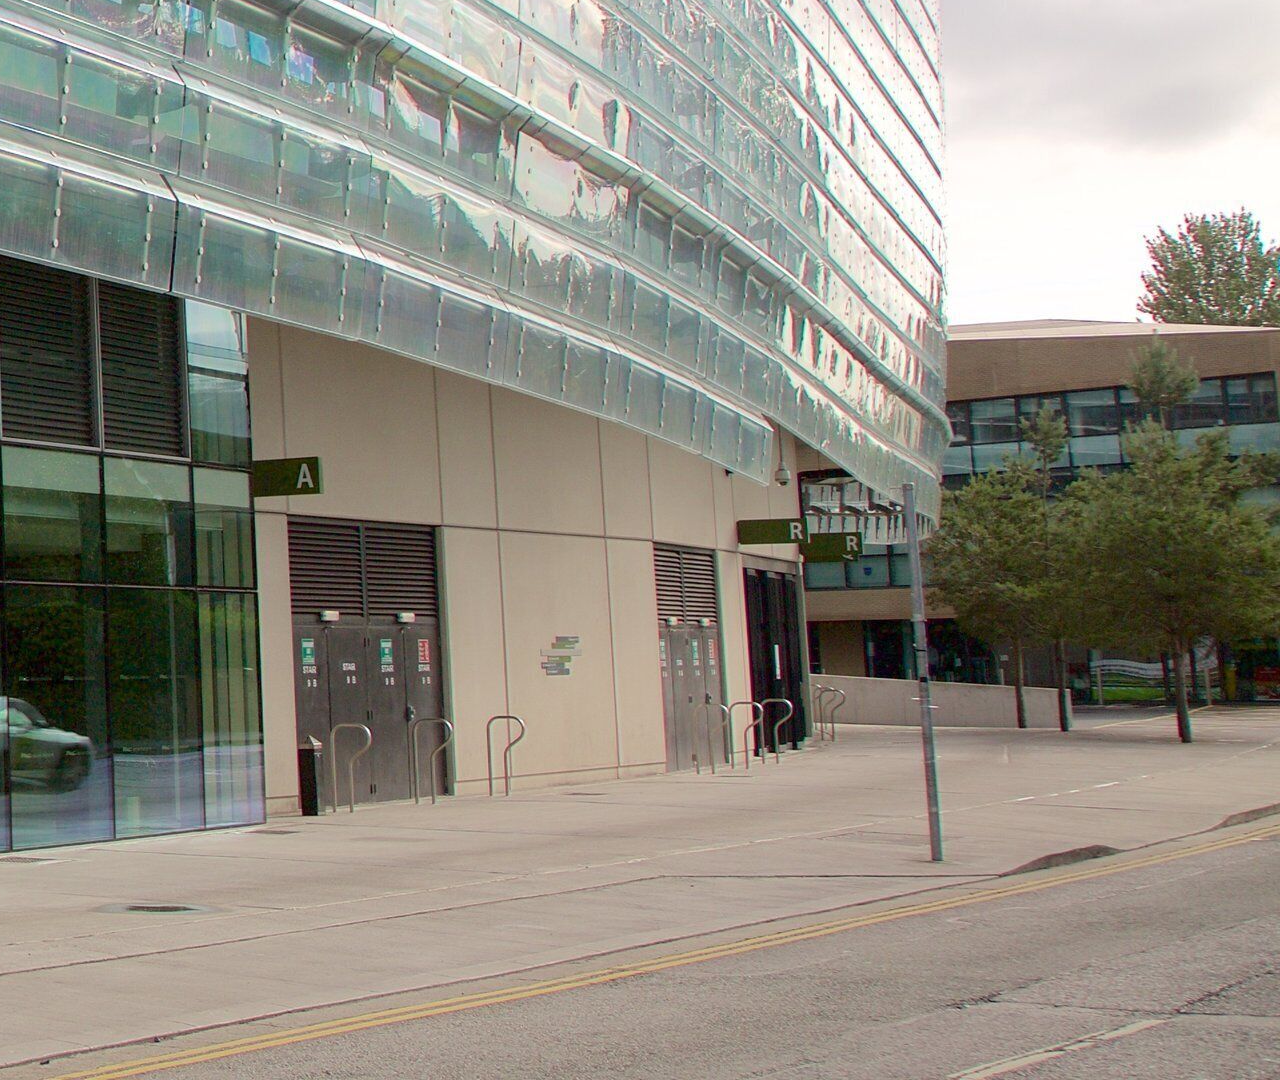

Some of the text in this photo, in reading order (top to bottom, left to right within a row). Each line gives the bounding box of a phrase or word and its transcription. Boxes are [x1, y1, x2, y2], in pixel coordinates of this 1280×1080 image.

[296, 463, 314, 489] A
[789, 522, 804, 540] R
[845, 535, 859, 552] R
